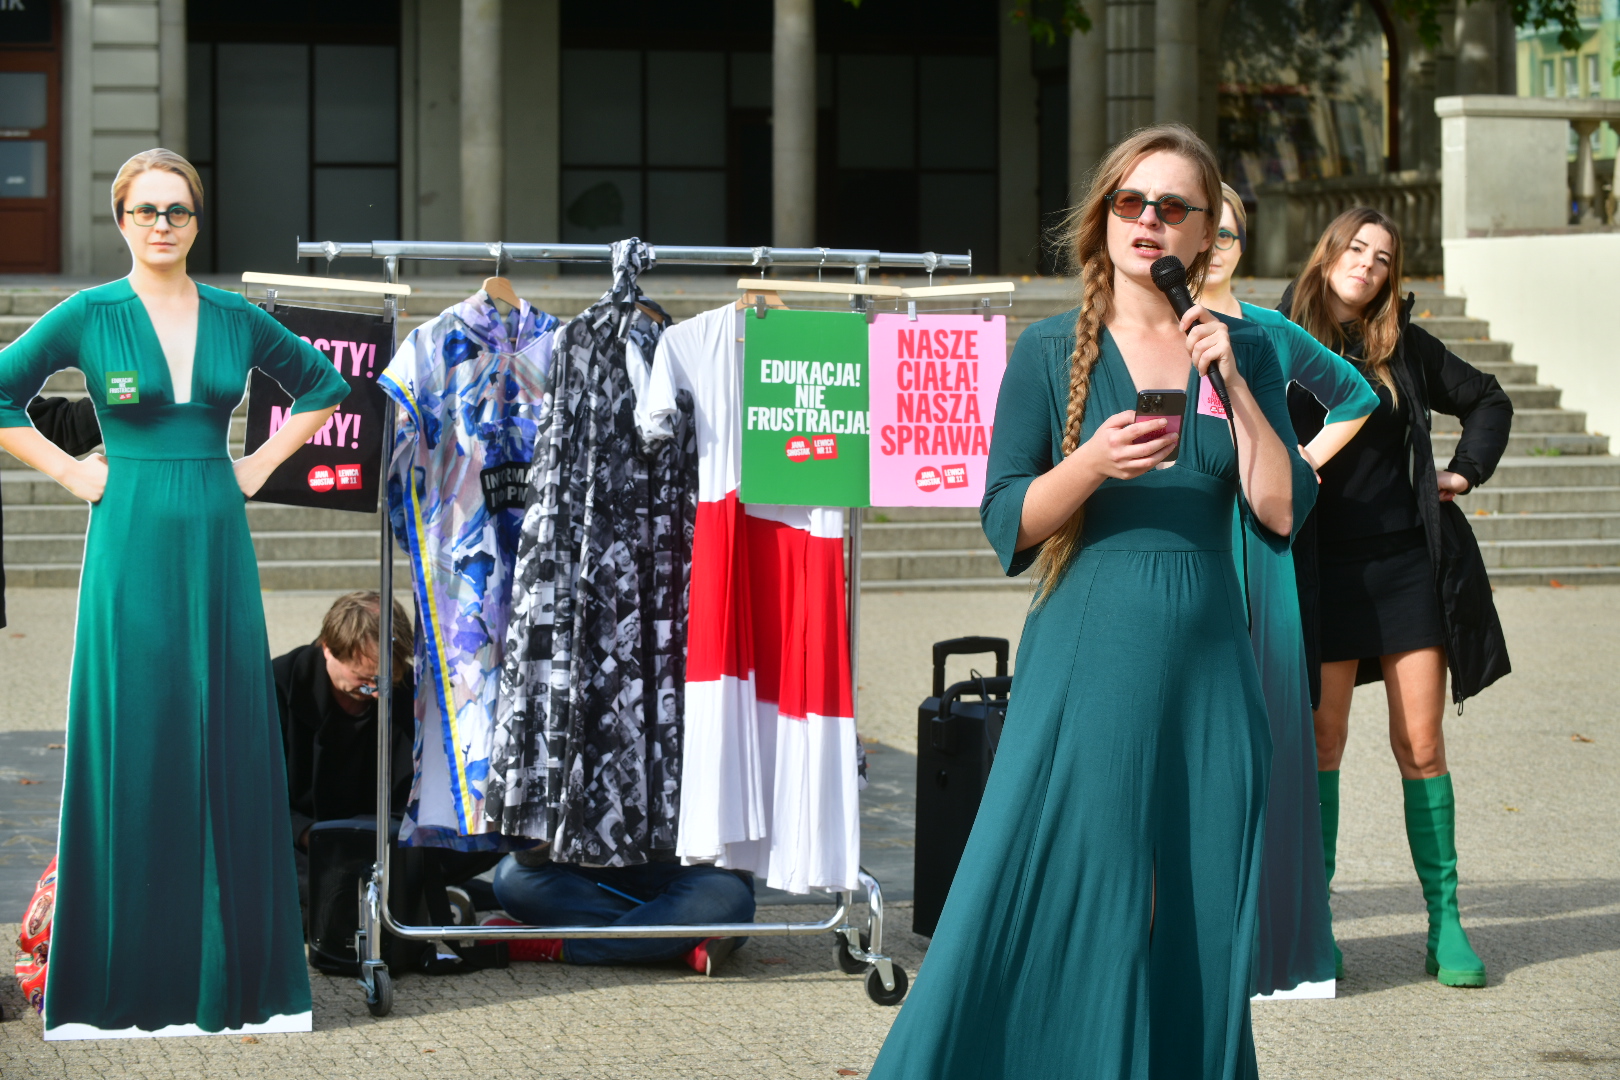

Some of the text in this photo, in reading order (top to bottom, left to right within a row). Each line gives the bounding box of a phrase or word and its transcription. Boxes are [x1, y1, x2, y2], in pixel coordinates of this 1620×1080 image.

[897, 329, 978, 360] NASZE
[760, 359, 861, 387] EDUKACJA!
[897, 361, 978, 392] CIAŁA!
[795, 385, 826, 409] NIE
[897, 392, 981, 424] NASZA
[813, 438, 835, 447] LEWICA
[880, 425, 994, 456] SPRAWA
[309, 477, 335, 487] SHOSTAK
[314, 470, 329, 479] JANA
[338, 468, 359, 477] LEWICA
[943, 467, 965, 477] LEWICA
